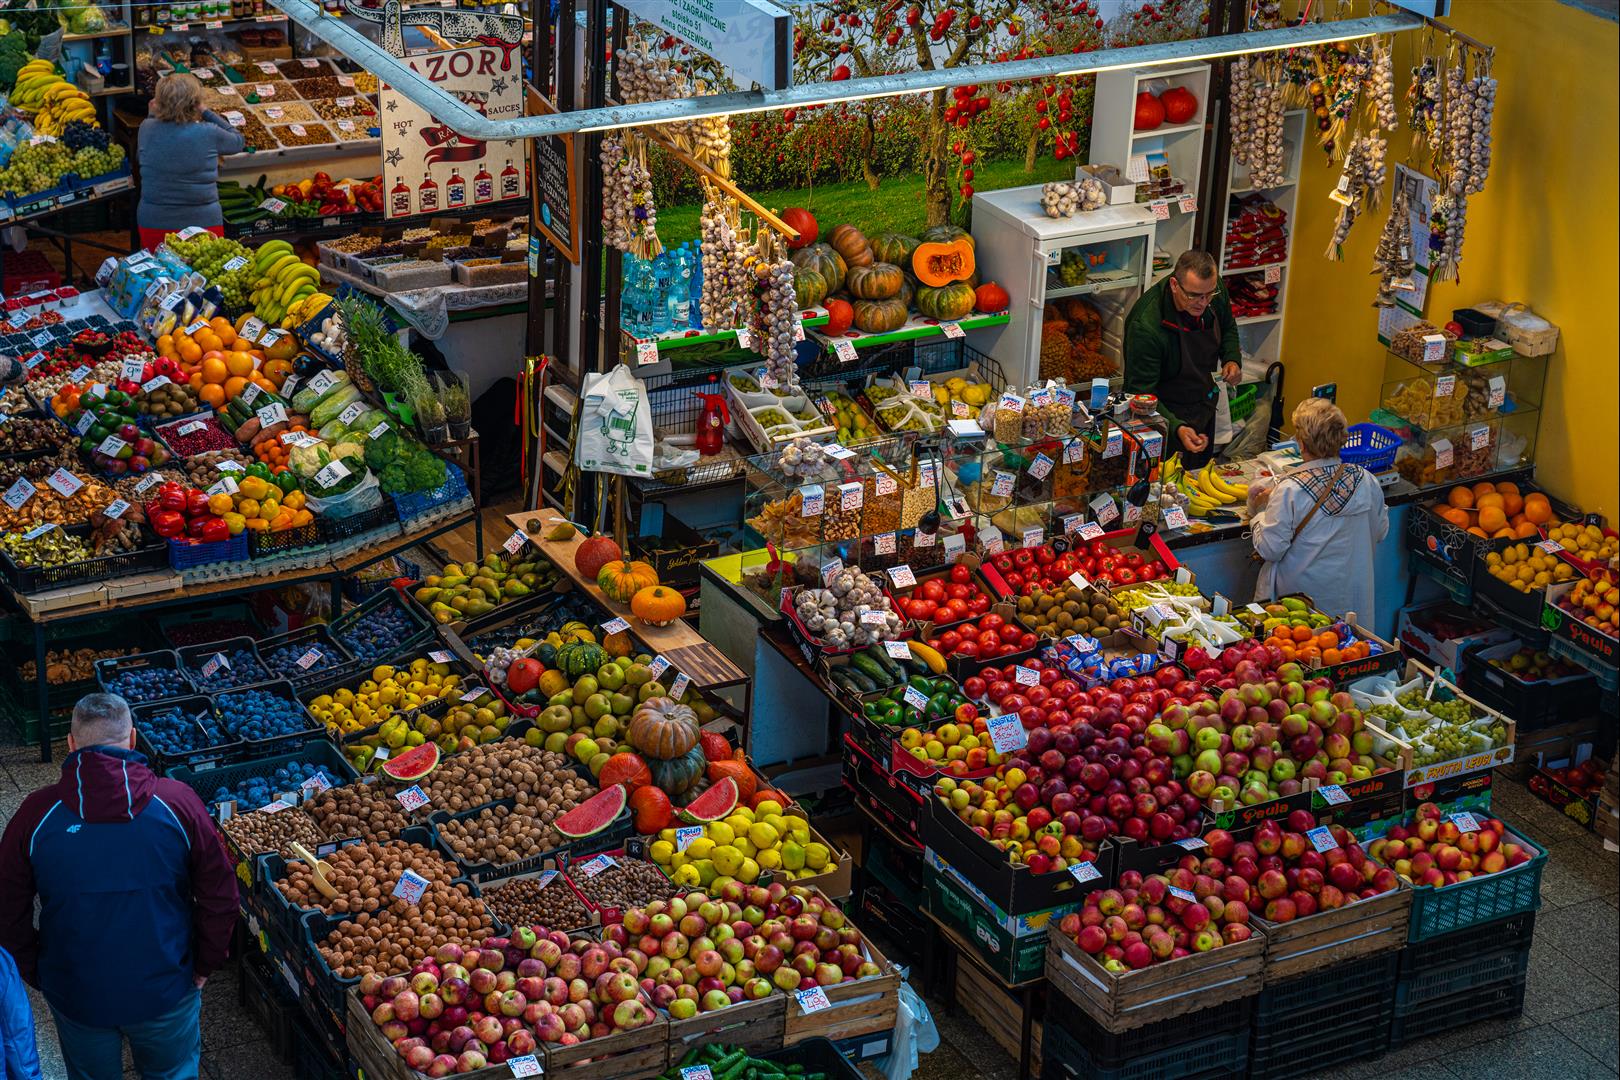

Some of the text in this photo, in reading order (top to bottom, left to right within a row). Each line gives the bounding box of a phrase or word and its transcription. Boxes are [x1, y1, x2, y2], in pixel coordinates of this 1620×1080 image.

[672, 10, 702, 31] stoisko 51
[683, 1, 726, 32] ZAGRANICZNE
[661, 15, 713, 51] Anna CISZEWSKA
[409, 50, 496, 82] ZOR
[488, 104, 520, 115] SAUCES
[393, 120, 413, 130] HOT
[1569, 623, 1612, 656] Paula
[1337, 661, 1380, 679] Paula
[1426, 762, 1463, 779] FRUTTA
[1241, 803, 1289, 824] Paula
[66, 825, 82, 834] 4F
